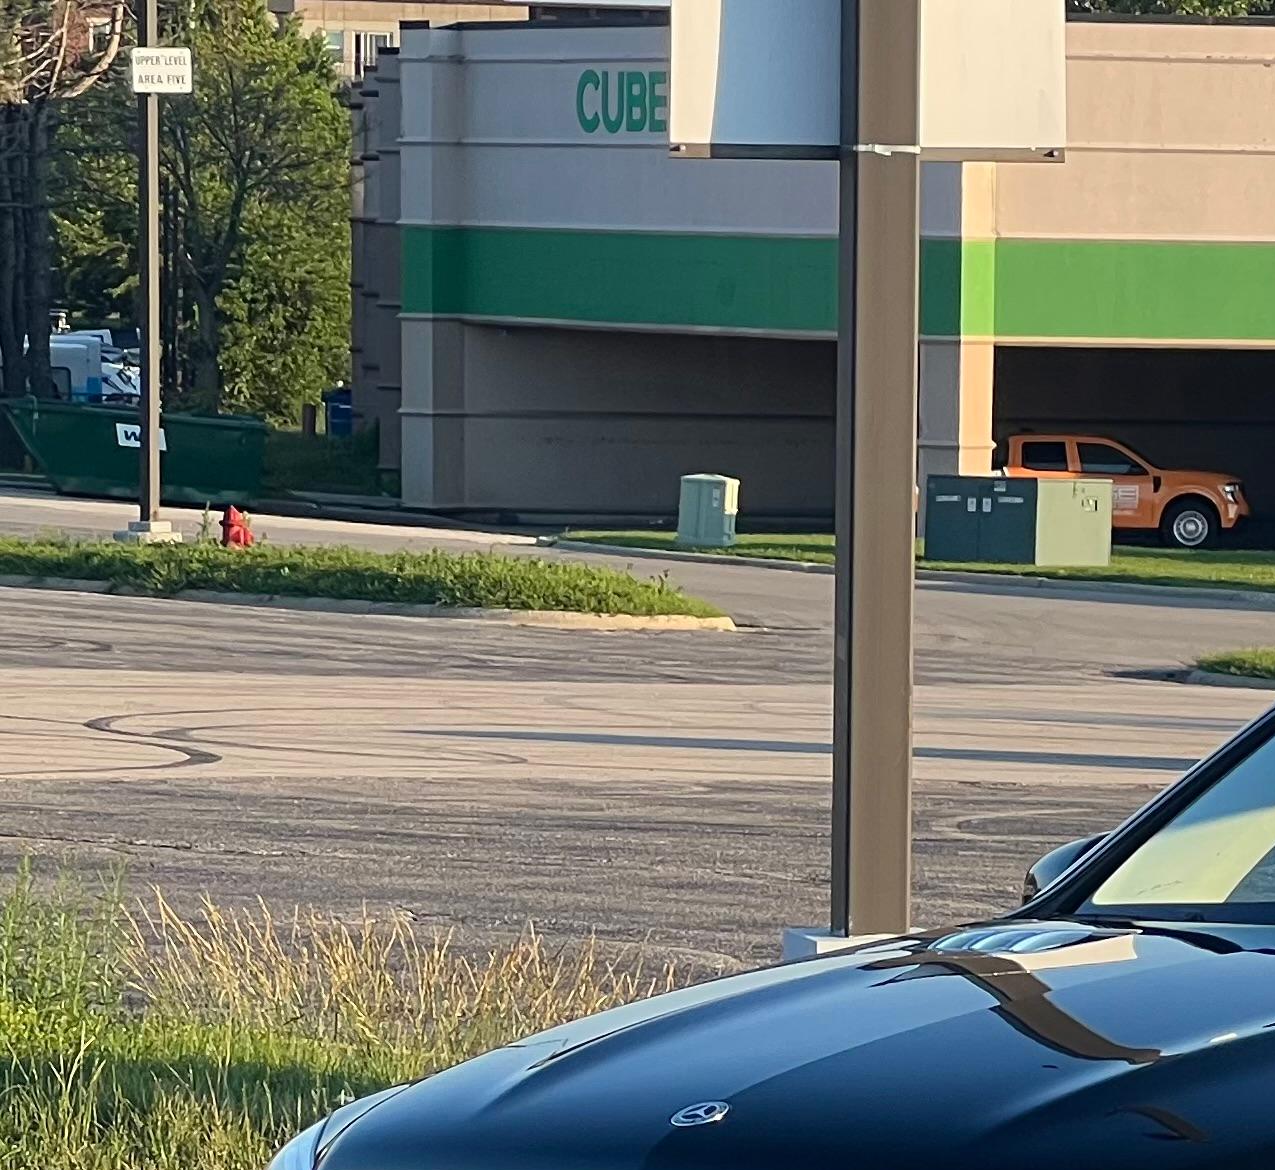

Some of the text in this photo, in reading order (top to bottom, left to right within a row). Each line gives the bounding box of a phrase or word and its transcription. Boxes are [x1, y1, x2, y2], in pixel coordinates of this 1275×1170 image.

[135, 55, 187, 66] UPPER LEVEL
[138, 74, 186, 85] AREA FIVE
[576, 69, 668, 133] CUBE
